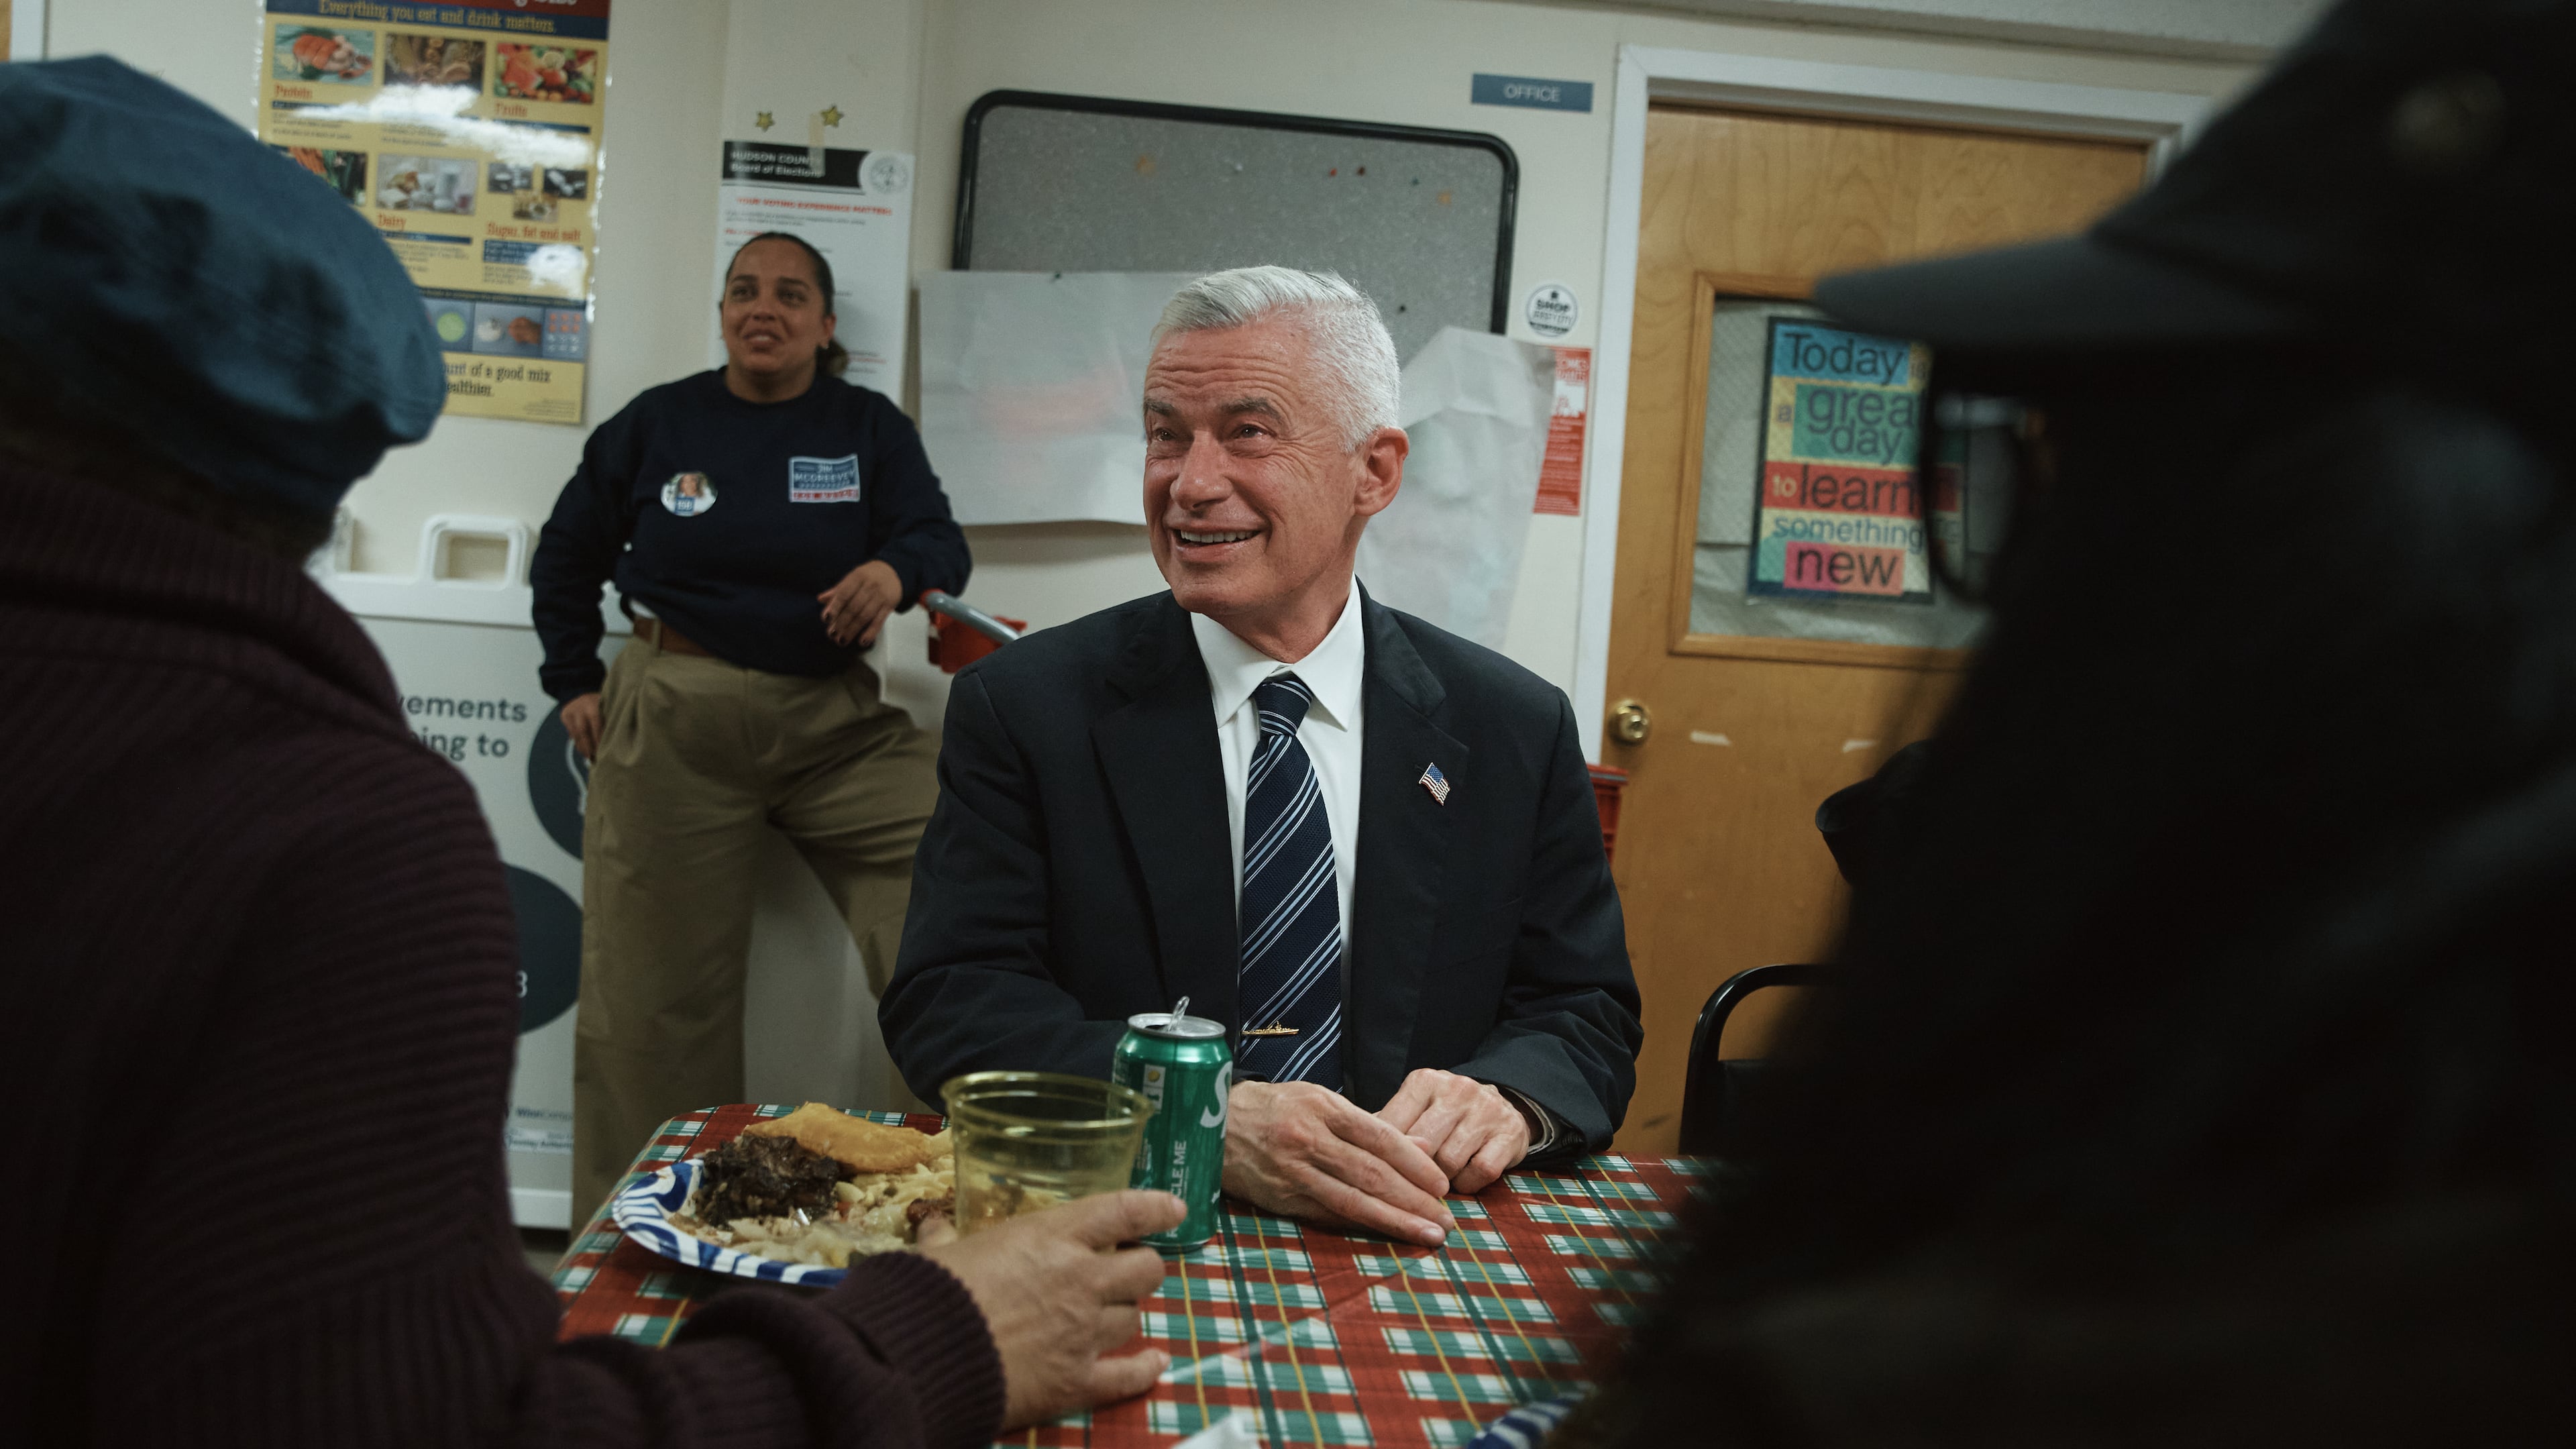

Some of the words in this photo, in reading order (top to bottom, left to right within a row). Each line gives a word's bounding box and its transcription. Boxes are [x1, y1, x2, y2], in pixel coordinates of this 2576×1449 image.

[319, 1, 388, 22] Everything
[392, 7, 414, 23] you
[417, 9, 437, 21] eat
[441, 8, 464, 24] and
[467, 10, 502, 27] drink
[1503, 83, 1561, 103] OFFICE
[731, 150, 776, 162] HUDSON
[731, 163, 761, 174] Board
[761, 165, 773, 174] of
[797, 202, 850, 213] EXPERIENCE
[378, 213, 407, 230] Dairy
[1784, 333, 1903, 386] Today
[472, 363, 484, 376] of
[486, 368, 492, 378] a
[496, 365, 525, 382] good
[529, 368, 552, 383] mix
[447, 380, 494, 397] ealthier.
[1778, 404, 1792, 423] a
[1808, 388, 1913, 434] grea
[1830, 419, 1904, 466] day
[1772, 474, 1797, 498] to
[1801, 464, 1918, 515] learn
[1772, 517, 1923, 555] something
[1796, 548, 1899, 587] new
[477, 734, 510, 758] to
[1173, 1141, 1187, 1165] ME
